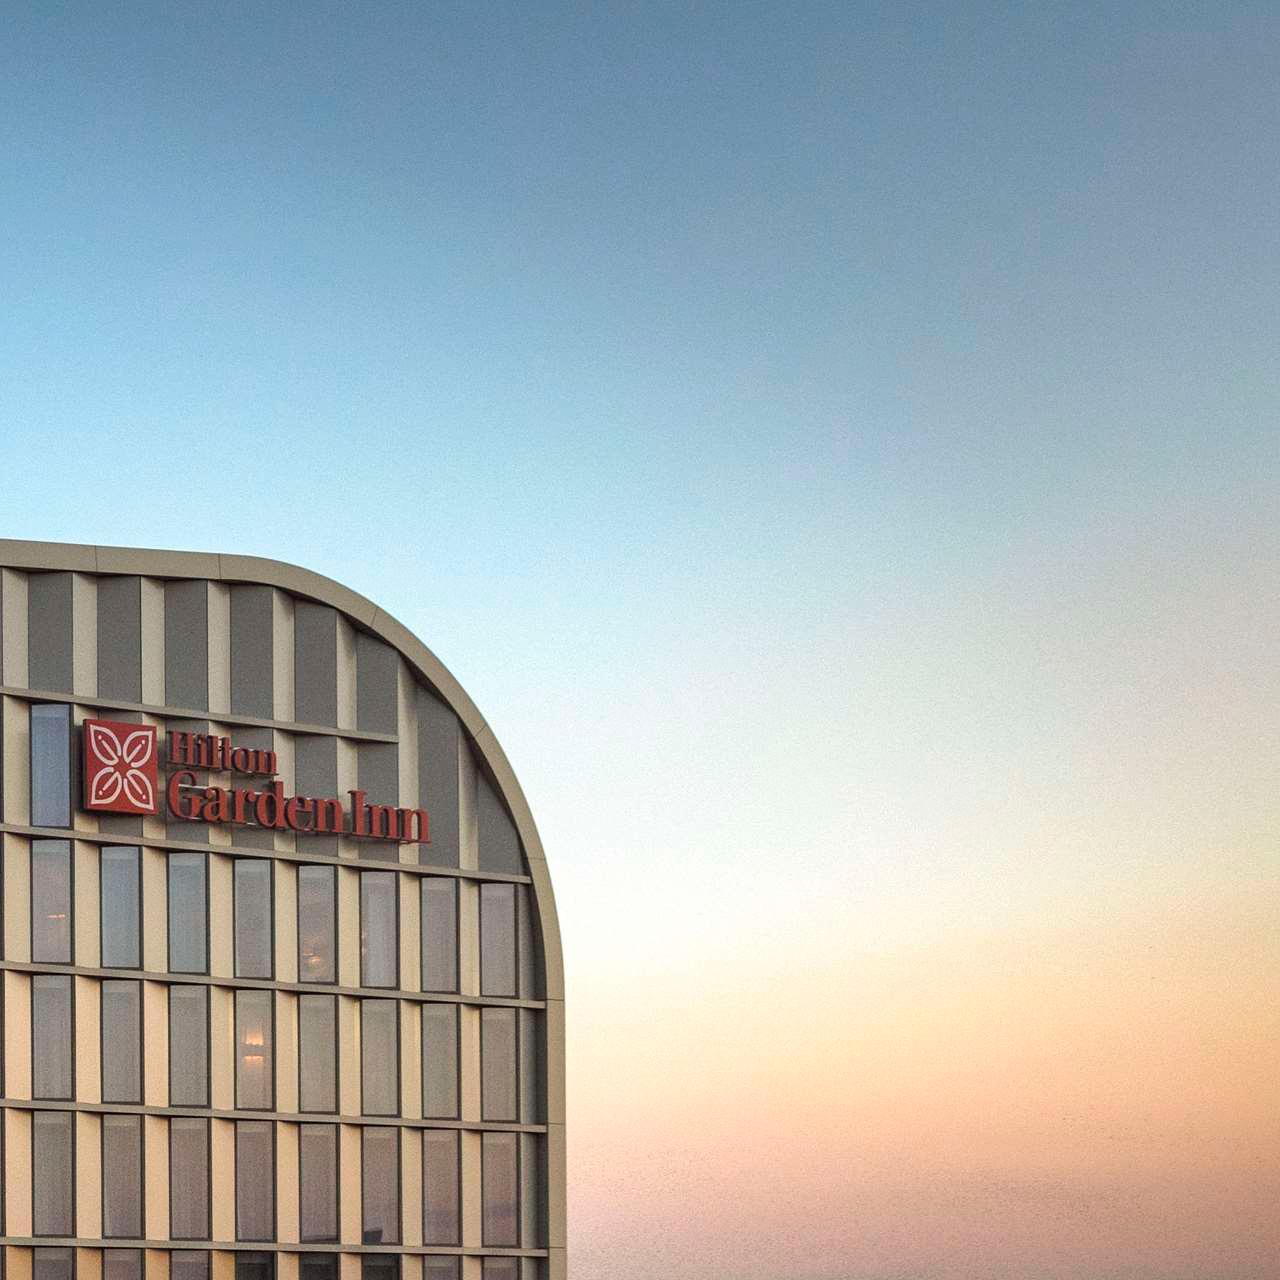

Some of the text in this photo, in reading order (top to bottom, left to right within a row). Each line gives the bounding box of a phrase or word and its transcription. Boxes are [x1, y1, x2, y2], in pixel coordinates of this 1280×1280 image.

[167, 730, 278, 775] Hilton
[168, 771, 431, 843] Garden Inn
